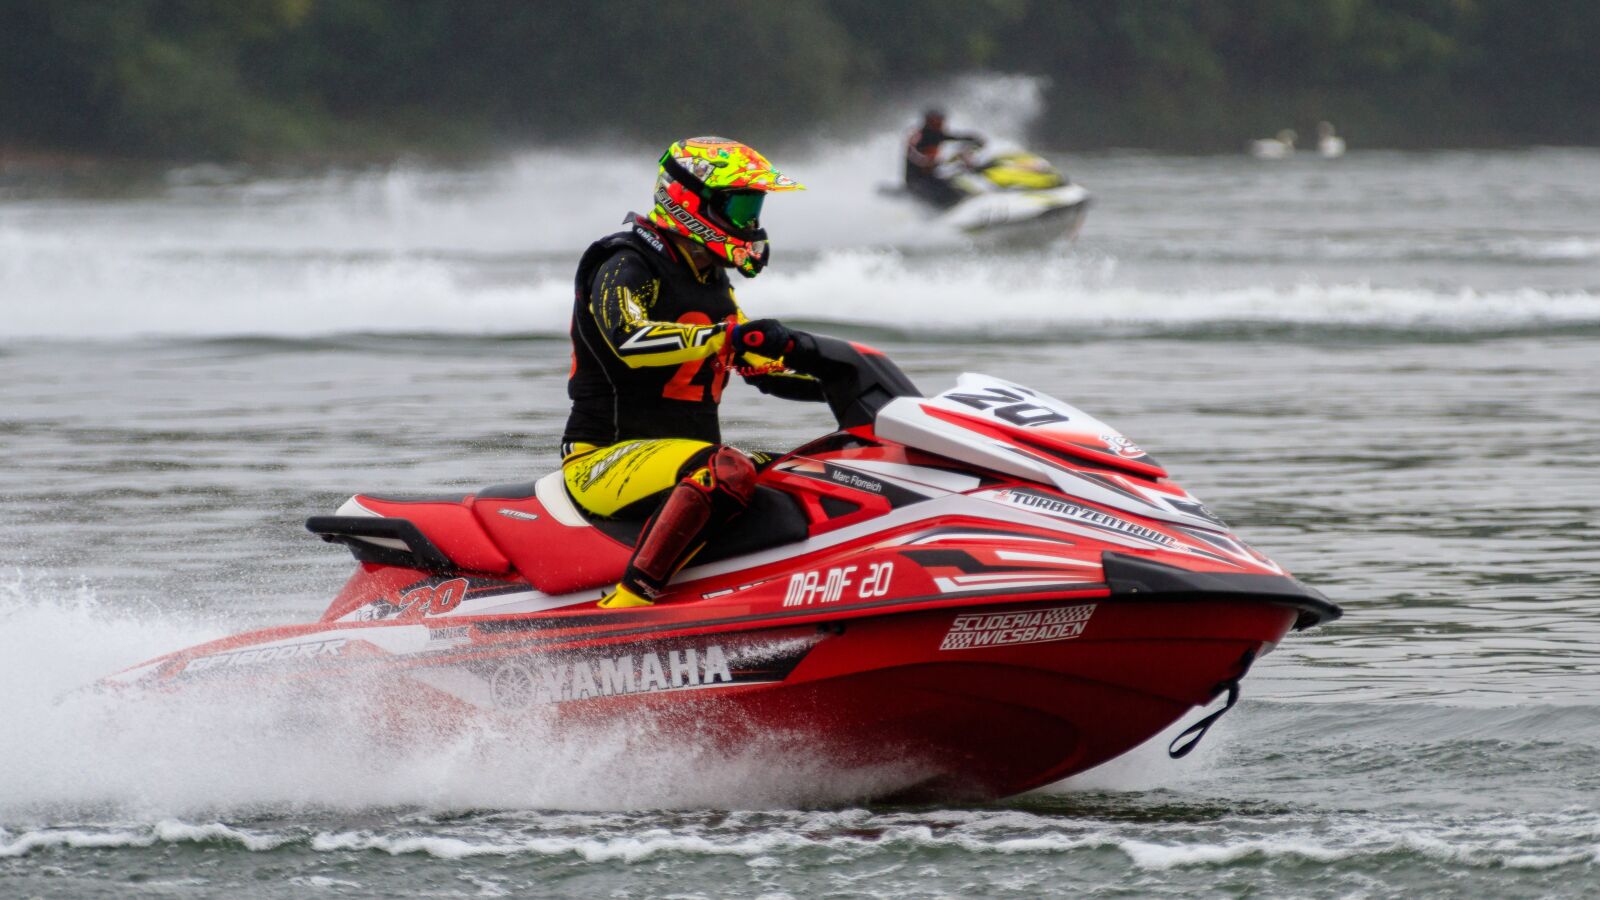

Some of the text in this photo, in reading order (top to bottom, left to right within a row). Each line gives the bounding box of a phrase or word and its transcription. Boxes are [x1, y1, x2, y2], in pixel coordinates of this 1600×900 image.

[654, 187, 727, 242] SUOMY
[637, 227, 664, 251] OMEGA
[944, 386, 1070, 427] 20
[832, 470, 850, 483] Marc
[397, 577, 469, 619] 20
[782, 562, 894, 607] MA-MF 20
[950, 612, 1042, 632] SCUDERIA
[973, 621, 1089, 646] WIESBADEN
[541, 645, 732, 703] YAMAHA
